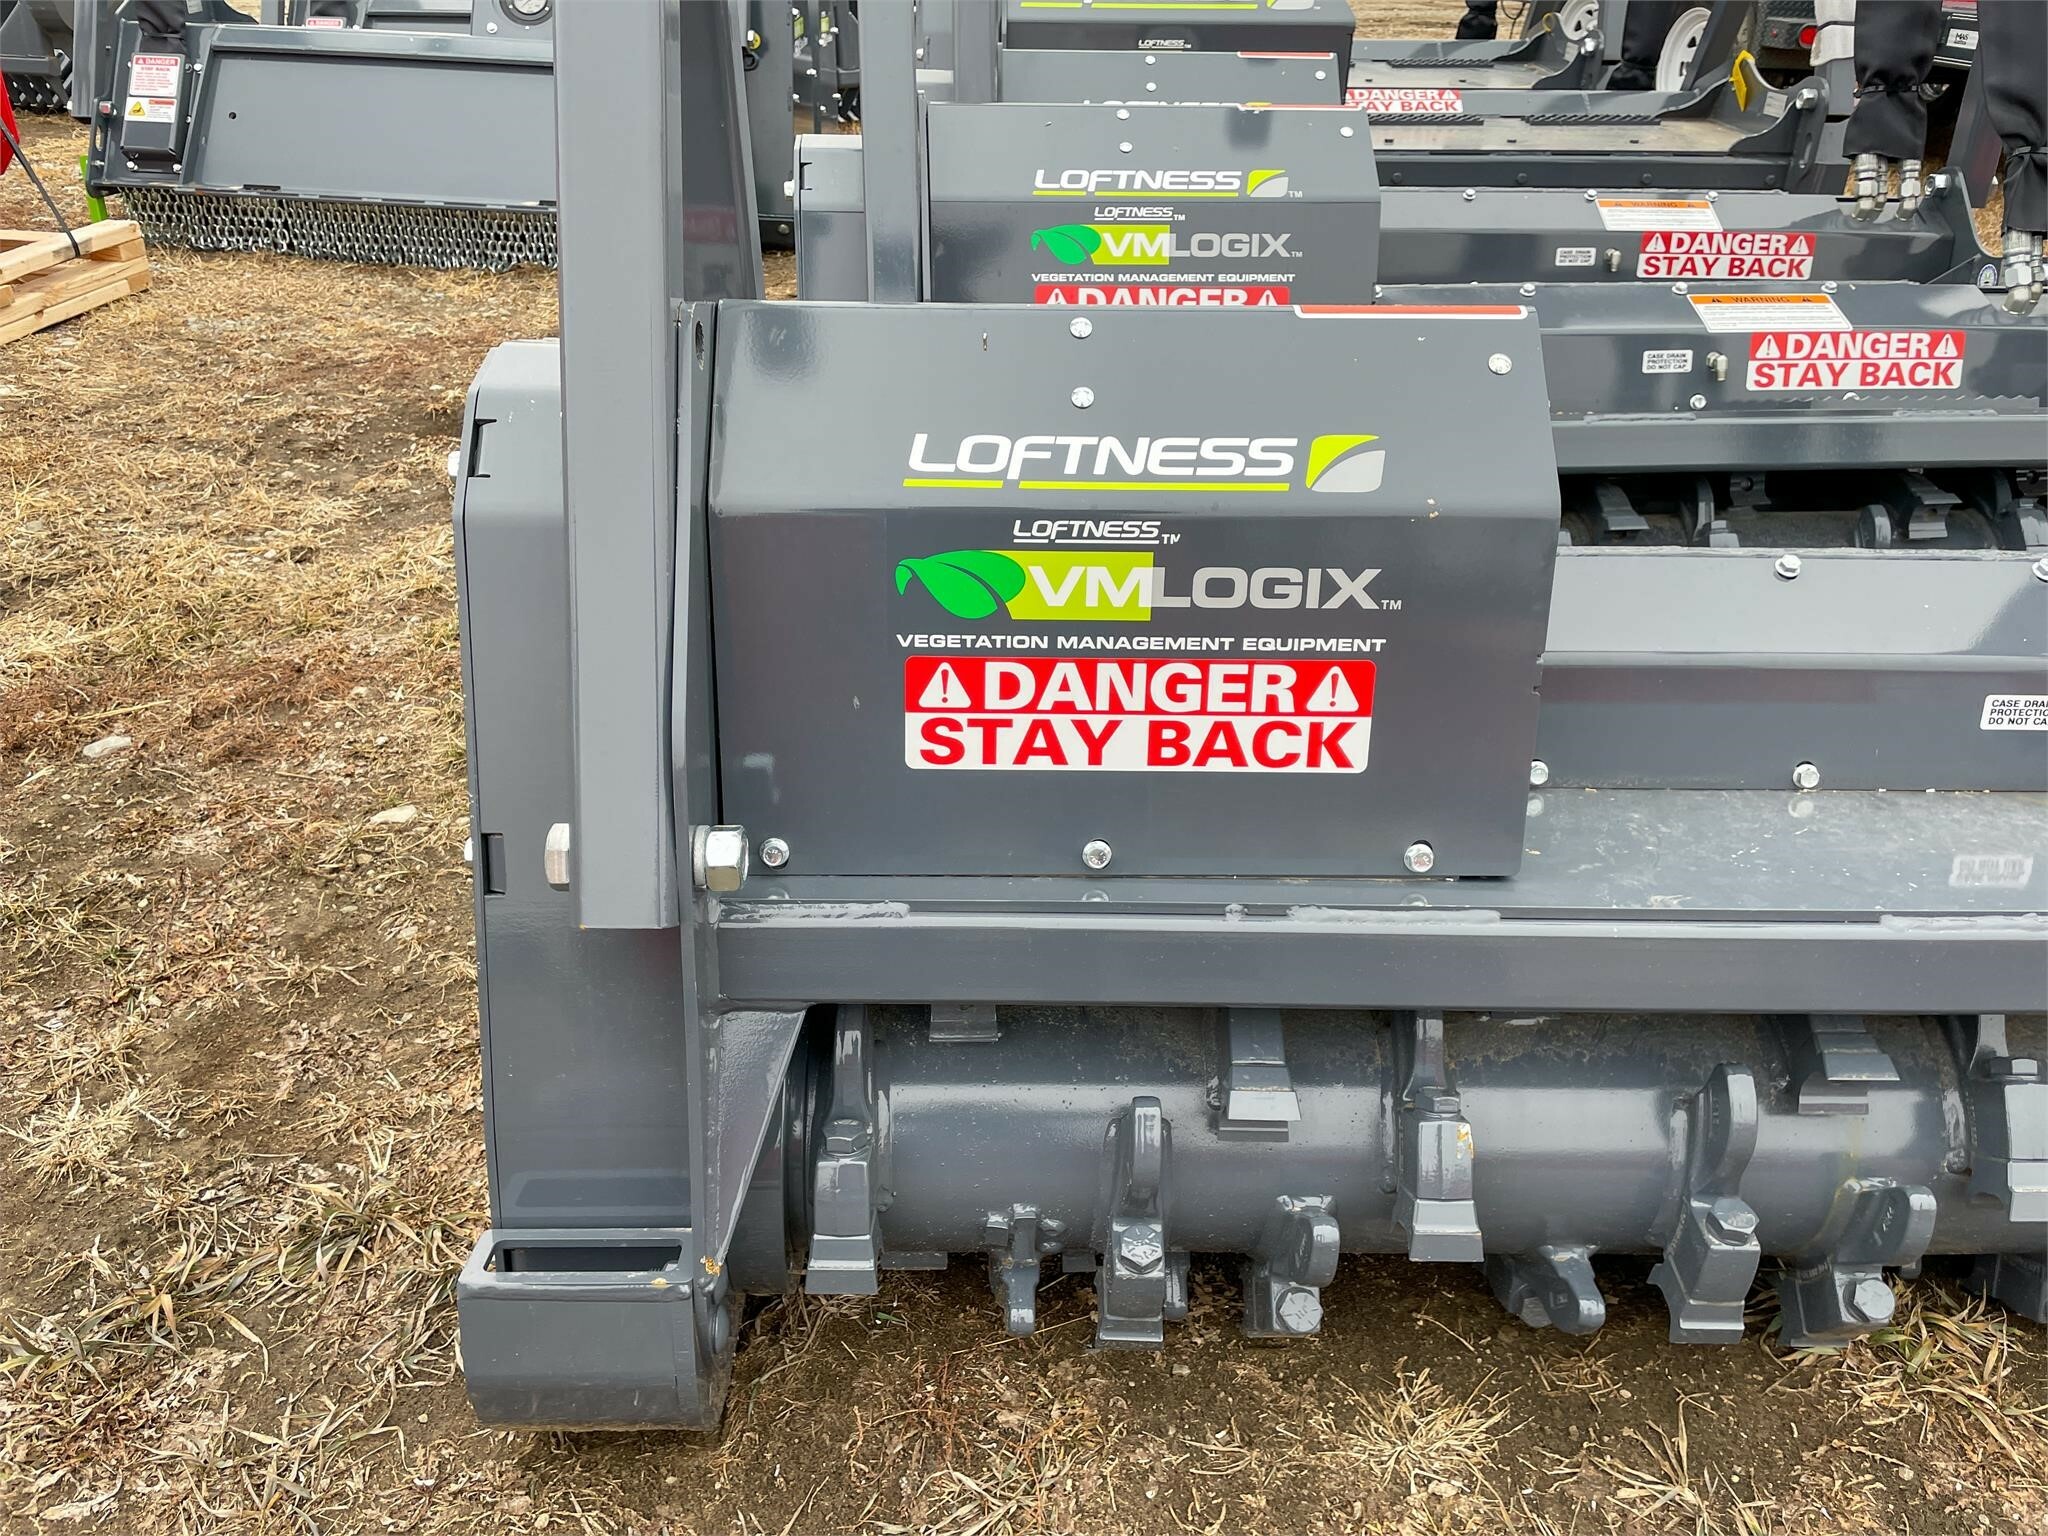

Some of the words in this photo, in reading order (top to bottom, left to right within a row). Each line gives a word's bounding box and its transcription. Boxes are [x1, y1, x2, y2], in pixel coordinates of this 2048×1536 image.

[1138, 39, 1185, 47] LOFTNESS
[145, 58, 176, 66] DANGER
[1355, 89, 1440, 100] DANGER
[1400, 101, 1459, 112] BACK
[1034, 168, 1242, 192] LOFTNESS
[1094, 206, 1174, 218] LOFTNESS
[1102, 232, 1292, 258] VMLOGIX
[1669, 232, 1789, 255] DANGER
[1031, 273, 1114, 282] VEGETATION
[1117, 273, 1215, 282] MANAGEMENT
[1218, 273, 1296, 282] EQUIPMENT
[1643, 255, 1721, 277] STAY
[1727, 257, 1808, 278] BACK
[1731, 296, 1790, 304] WARNING
[1785, 332, 1932, 360] DANGER
[1753, 361, 1850, 388] STAY
[1859, 361, 1957, 387] BACK
[908, 432, 1298, 480] LOFTNESS
[1013, 519, 1162, 541] LOFTNESS
[1027, 565, 1383, 610] VMLOGIX
[896, 633, 1049, 650] VEGETATION
[1056, 635, 1235, 652] MANAGEMENT
[1242, 637, 1387, 653] EQUIPMENT
[983, 660, 1298, 714] DANGER
[1992, 699, 2020, 708] CASE
[1988, 717, 2004, 725] DO
[2008, 717, 2030, 725] NOT
[919, 717, 1124, 767] STAY
[1146, 719, 1358, 769] BACK
